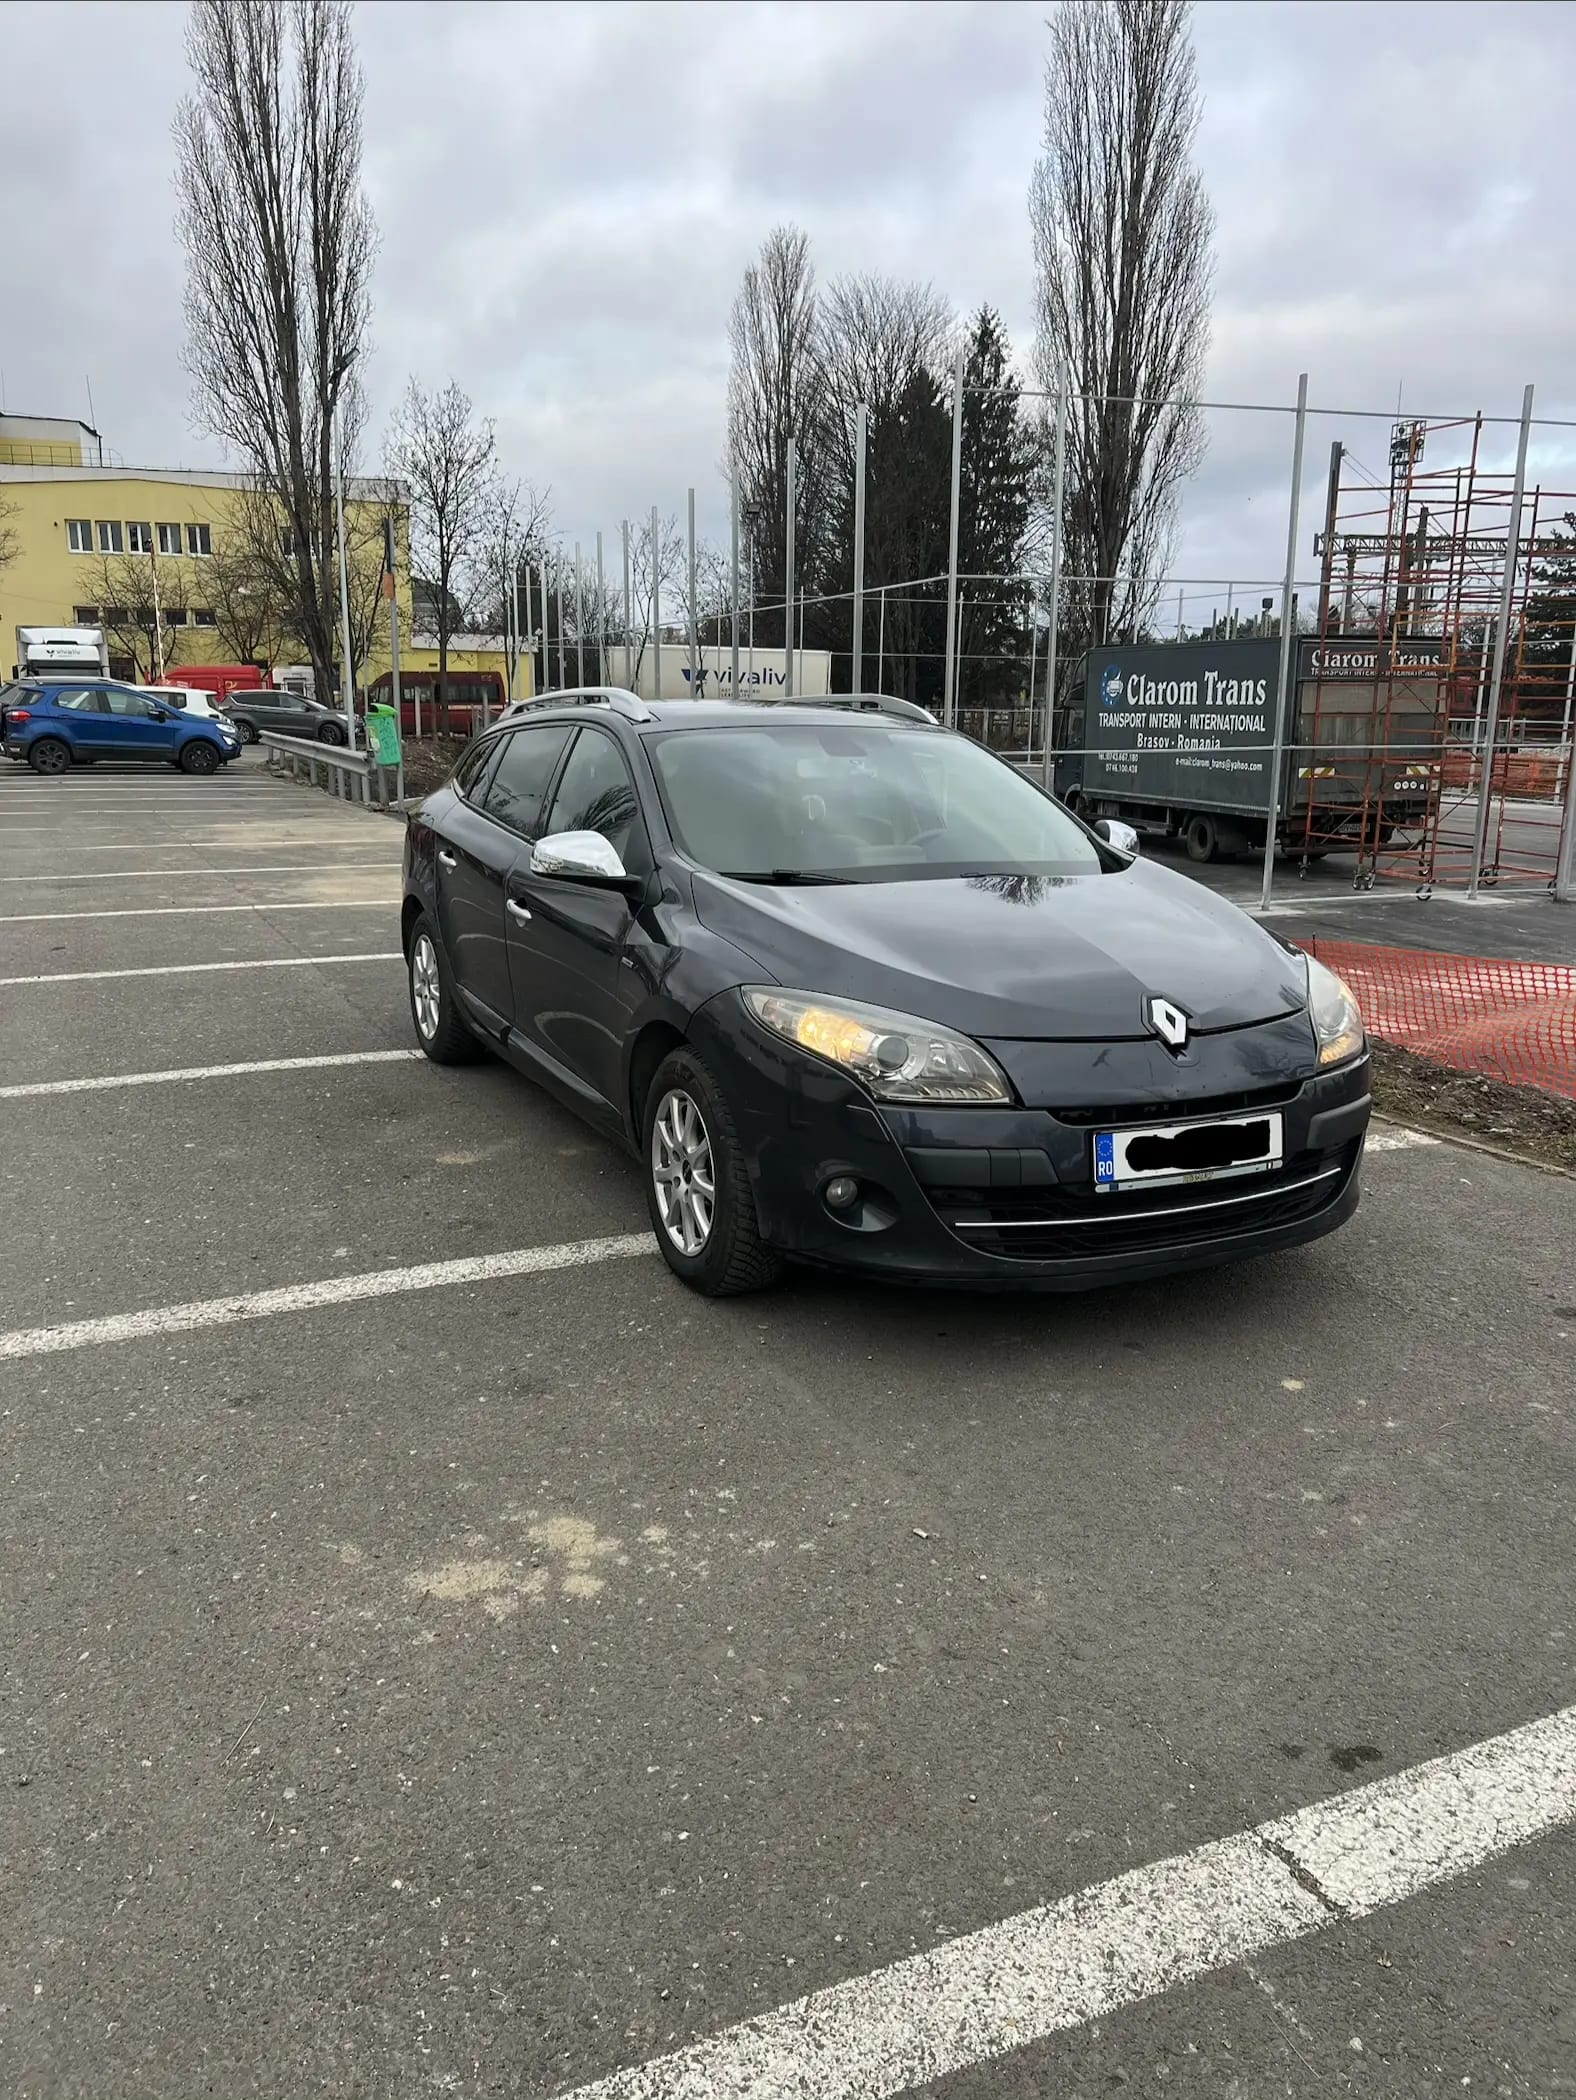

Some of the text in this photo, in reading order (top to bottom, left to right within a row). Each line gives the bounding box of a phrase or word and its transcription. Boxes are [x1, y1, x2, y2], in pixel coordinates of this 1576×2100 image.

[1127, 670, 1267, 706] Clarom Trans
[1099, 713, 1147, 728] TRANSPORT
[1150, 713, 1181, 729] INTERN
[1137, 732, 1170, 748] Brasov
[1177, 734, 1221, 749] Romania
[1099, 1161, 1113, 1177] RO
